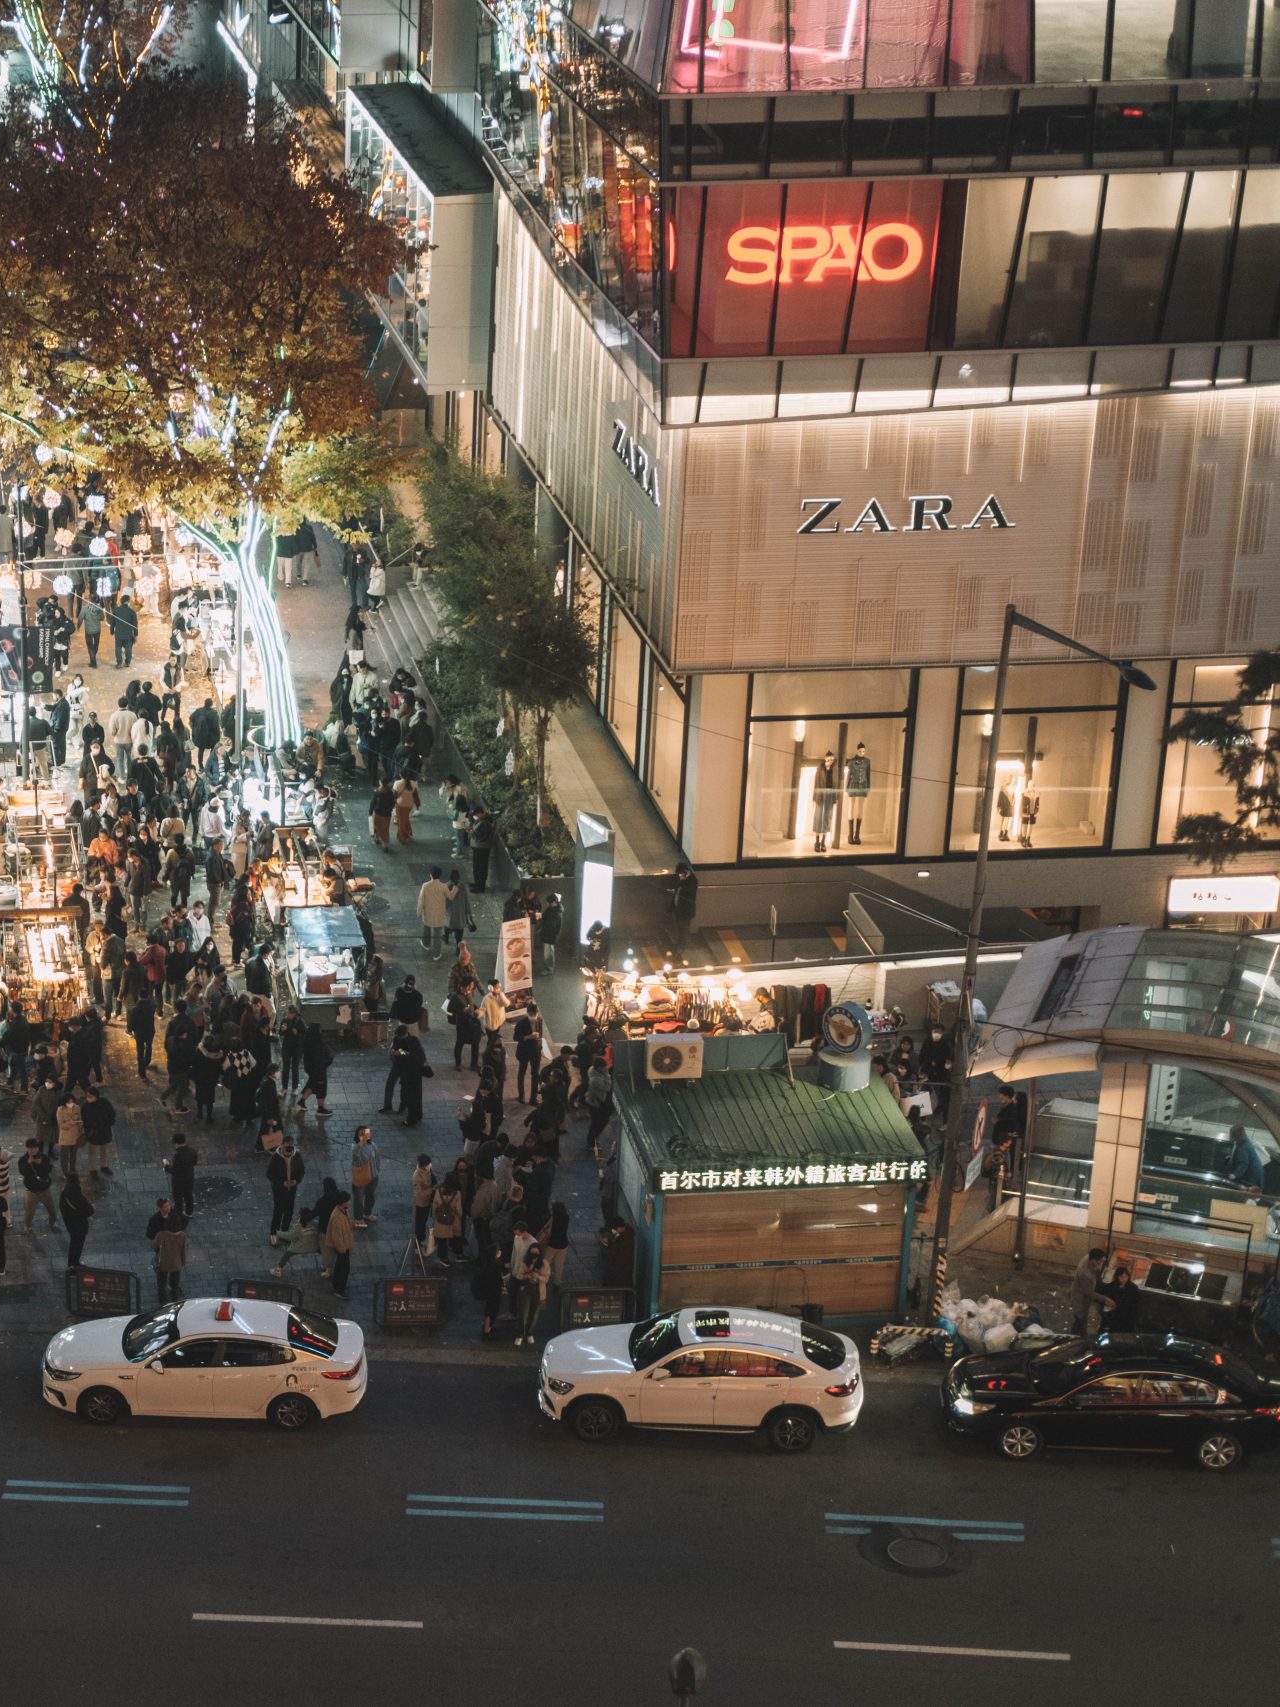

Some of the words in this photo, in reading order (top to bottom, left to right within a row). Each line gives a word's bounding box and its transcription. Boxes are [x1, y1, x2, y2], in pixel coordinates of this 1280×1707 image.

[725, 222, 923, 285] SPAO
[613, 419, 661, 506] ZARA
[797, 494, 1016, 534] ZARA
